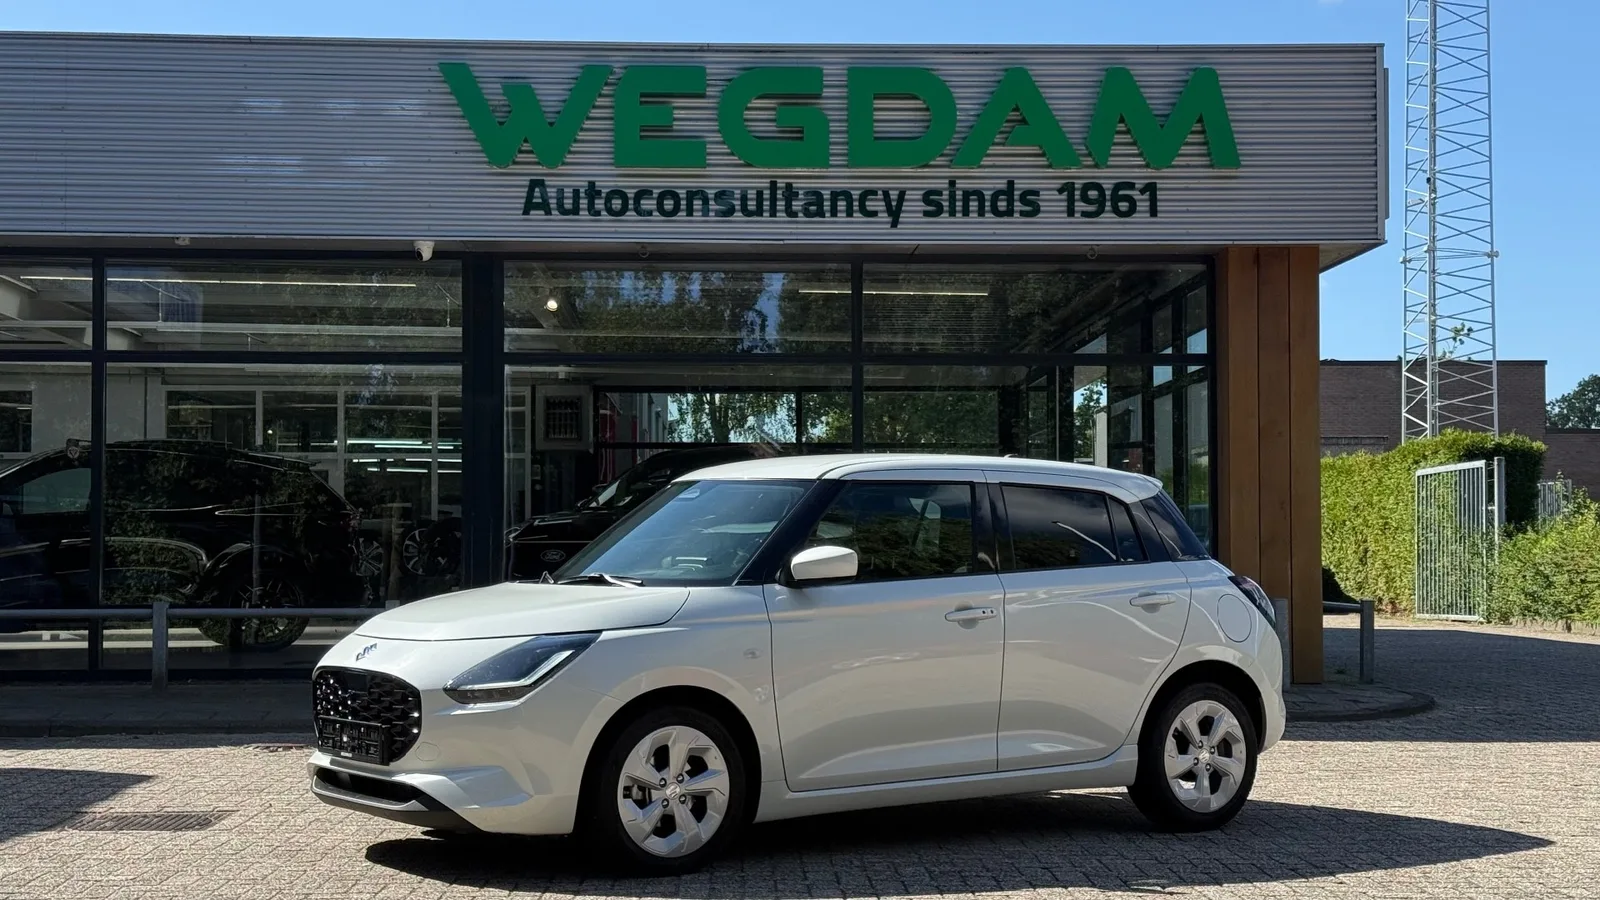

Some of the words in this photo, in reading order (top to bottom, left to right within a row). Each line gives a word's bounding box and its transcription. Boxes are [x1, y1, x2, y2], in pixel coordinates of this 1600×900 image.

[438, 62, 1241, 169] WEGDAM
[522, 178, 907, 228] Autoconsultancy
[922, 180, 1041, 218] sinds
[1056, 181, 1159, 218] 1961
